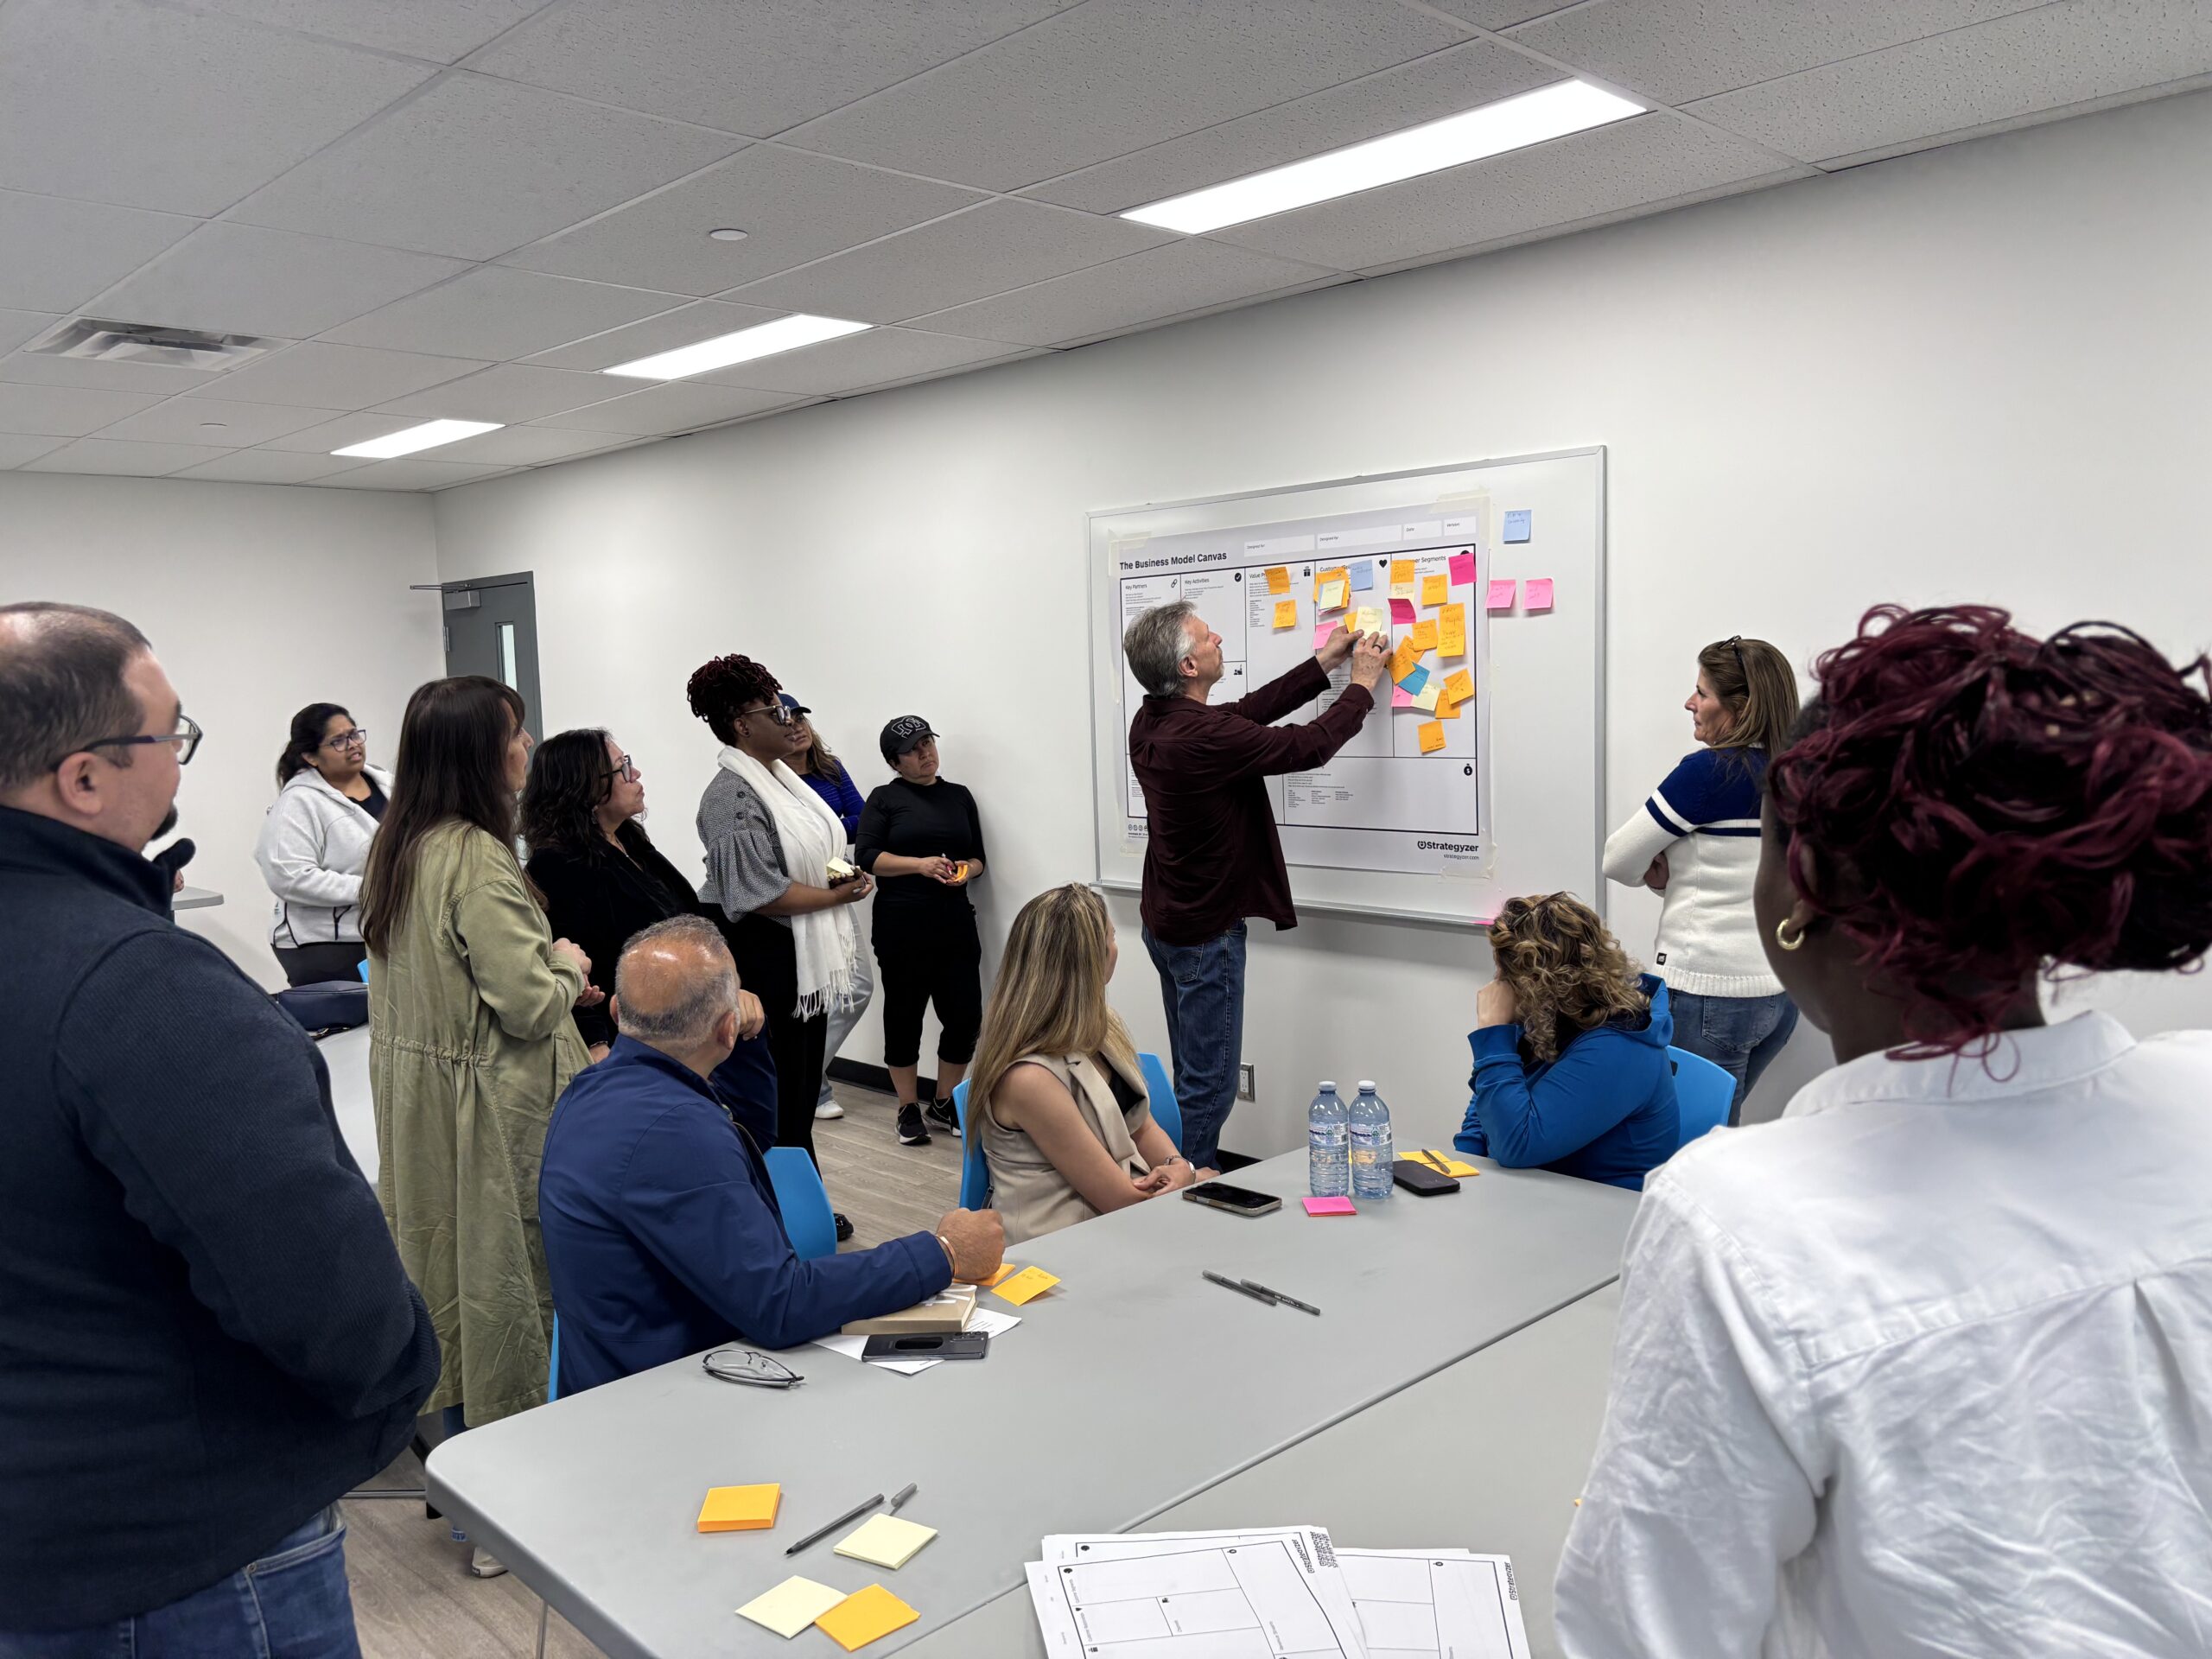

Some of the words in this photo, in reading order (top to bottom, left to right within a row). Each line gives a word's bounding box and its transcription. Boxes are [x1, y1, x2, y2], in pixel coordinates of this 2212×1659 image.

[1120, 562, 1133, 570] The
[1135, 557, 1169, 569] Business
[1171, 554, 1195, 564] Model
[1197, 552, 1227, 563] Canvas
[1427, 841, 1479, 853] Strategyzer
